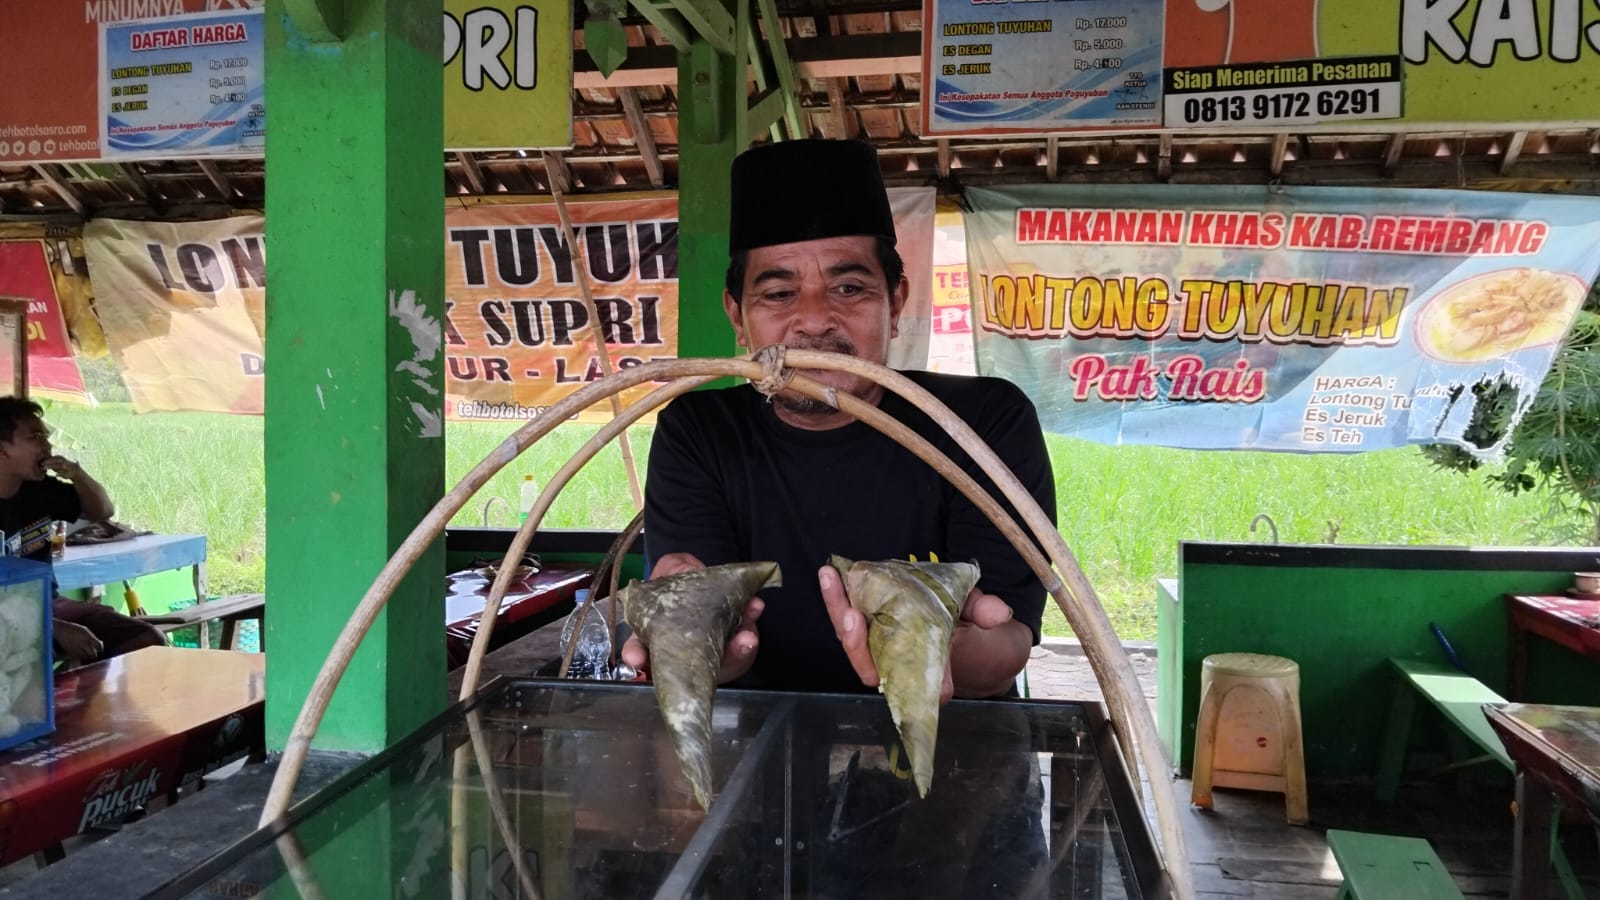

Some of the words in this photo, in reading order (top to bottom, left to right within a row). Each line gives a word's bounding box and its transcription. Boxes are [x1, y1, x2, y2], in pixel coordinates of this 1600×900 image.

[85, 0, 184, 24] MINUMNYA
[944, 23, 994, 36] LONTONG
[998, 20, 1052, 33] TUYUHAN
[1075, 19, 1092, 32] Rp.
[1095, 17, 1126, 29] 17.000
[132, 28, 189, 51] DAFTAR
[192, 22, 248, 46] HARGA
[1075, 40, 1091, 52] Rp.
[1093, 38, 1122, 50] 5.000
[943, 46, 956, 56] ES
[958, 44, 992, 55] DEGAN
[112, 66, 149, 79] LONTONG
[151, 62, 192, 76] TUYUHAN
[943, 65, 956, 75] ES
[957, 62, 991, 74] JERUK
[1074, 59, 1091, 71] Rp.
[1092, 57, 1121, 69] 4.00
[1173, 71, 1212, 90] Siap
[1216, 65, 1308, 87] Menerima
[1312, 62, 1392, 81] Pesanan
[112, 86, 121, 97] ES
[950, 93, 1001, 102] Kesepakatan
[1003, 91, 1028, 100] Semua
[1031, 90, 1063, 100] Anggota
[112, 102, 121, 112] ES
[1184, 96, 1246, 123] 0813
[1253, 92, 1310, 119] 9172
[1317, 88, 1380, 116] 6291
[1018, 209, 1184, 244] MAKANAN
[1187, 211, 1285, 247] KHAS
[1288, 215, 1549, 256] KAB.REMBANG
[451, 222, 679, 286] TUYUH
[146, 235, 265, 292] LON
[980, 274, 1171, 337] LONTONG
[1179, 279, 1410, 344] TUYUHAN
[481, 296, 662, 346] SUPRI
[1070, 354, 1161, 401] Pak
[1167, 354, 1266, 401] Rais
[1315, 376, 1383, 391] HARGA
[1310, 394, 1386, 410] Lontong
[1305, 408, 1328, 423] Es
[1333, 410, 1385, 426] Jeruk
[1303, 427, 1326, 442] Es
[1331, 429, 1362, 444] Teh
